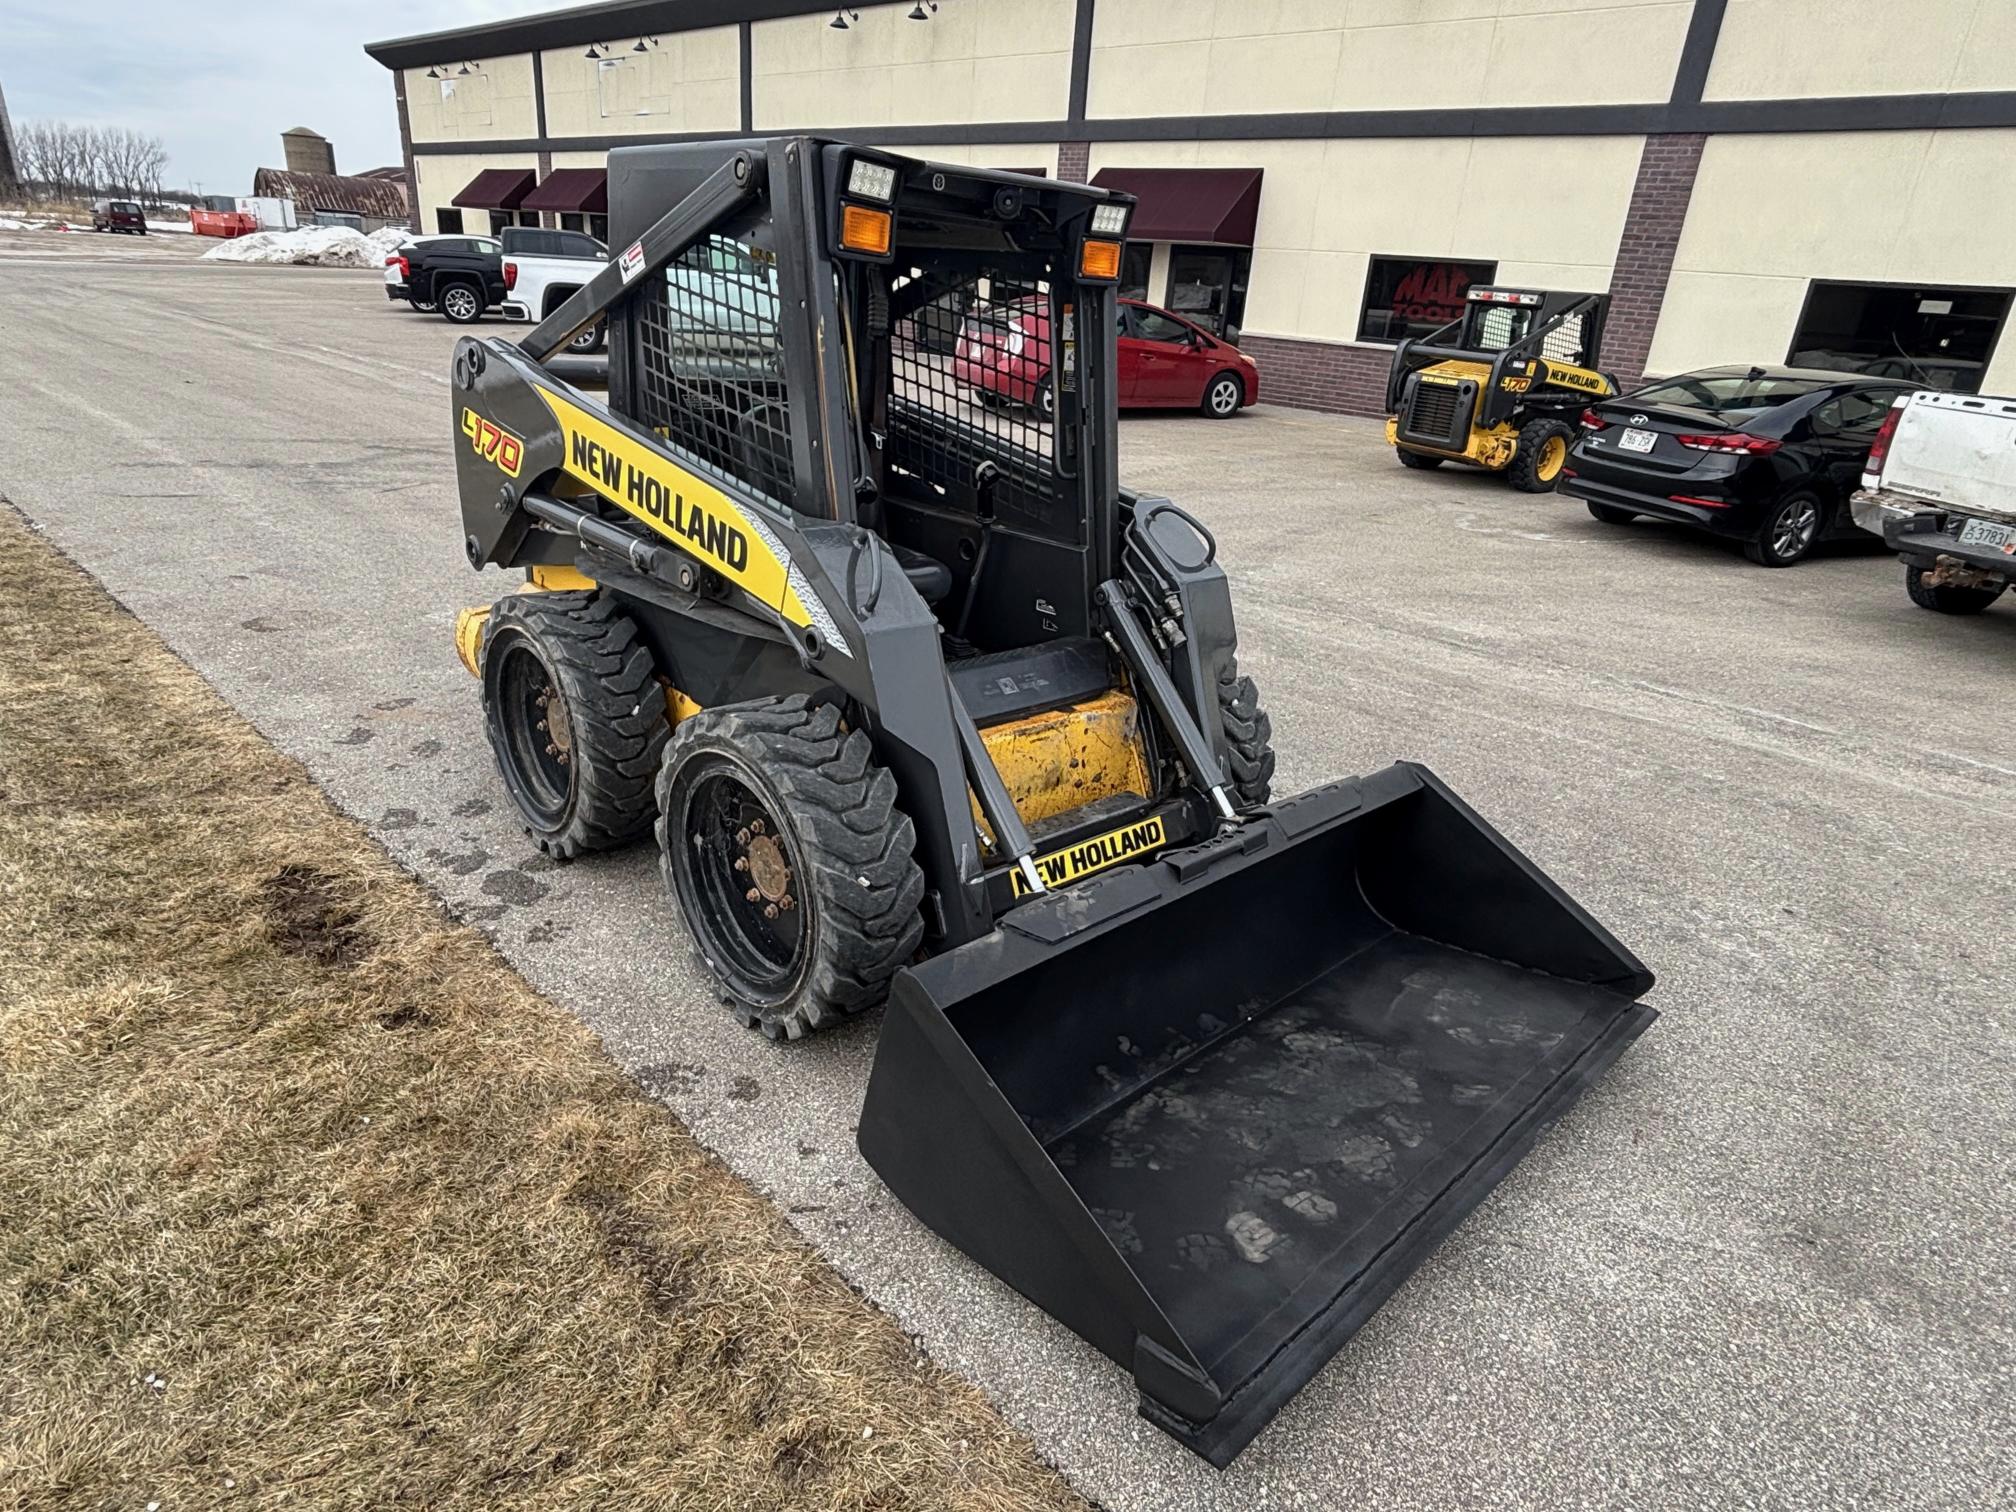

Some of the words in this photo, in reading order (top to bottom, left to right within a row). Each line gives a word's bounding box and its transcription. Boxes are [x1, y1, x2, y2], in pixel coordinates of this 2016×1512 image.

[1501, 377, 1530, 391] L170
[1549, 369, 1568, 382] NEW
[1567, 373, 1600, 389] HOLLAND
[462, 408, 522, 473] L170
[571, 430, 623, 492] NEW
[627, 464, 748, 573] HOLLAND
[1070, 821, 1161, 874] HOLLAND
